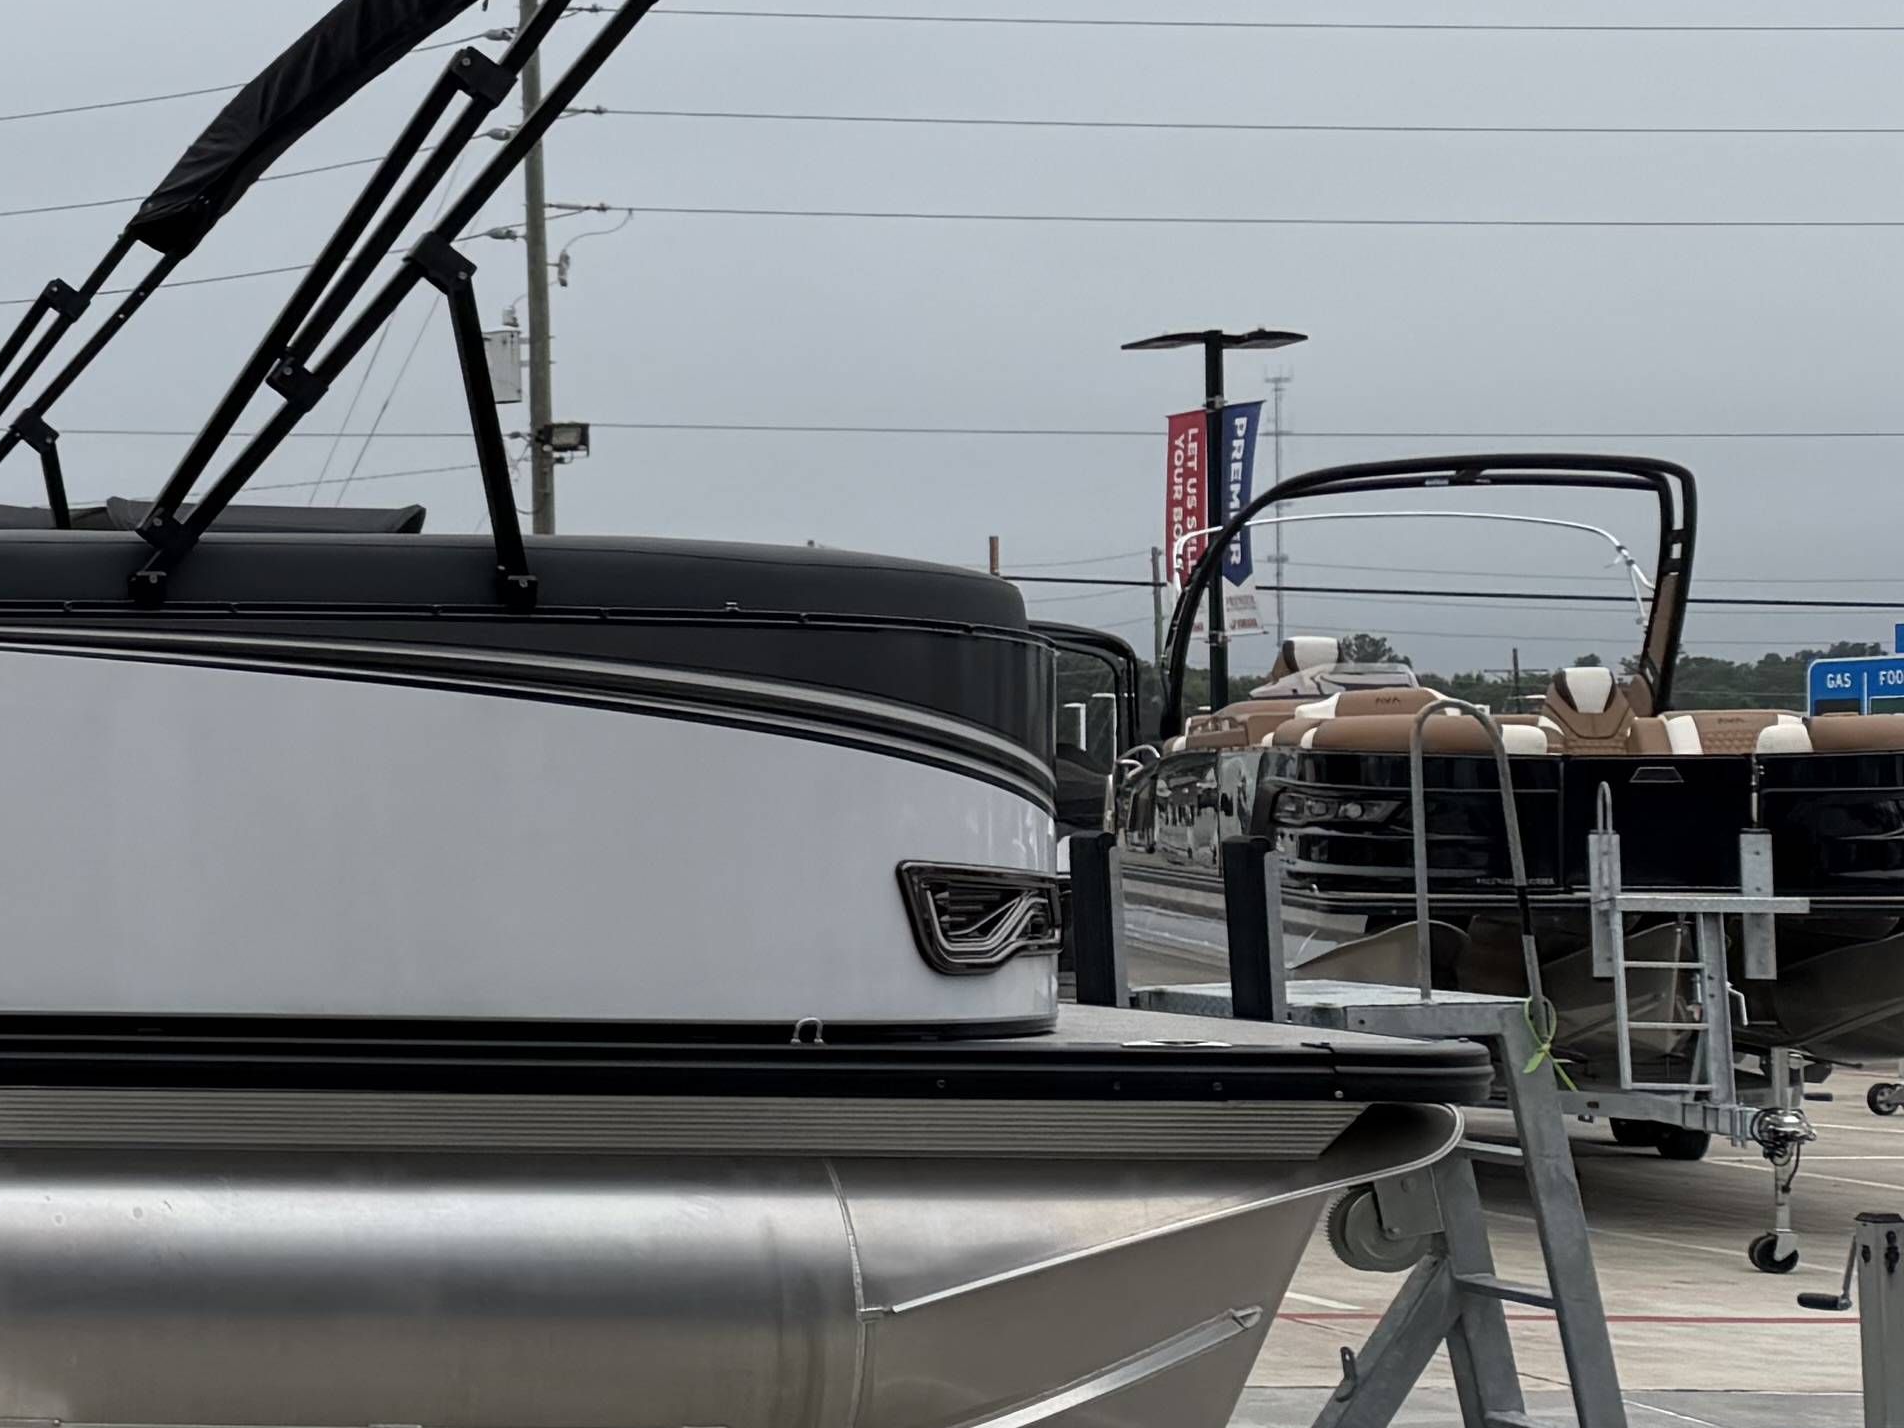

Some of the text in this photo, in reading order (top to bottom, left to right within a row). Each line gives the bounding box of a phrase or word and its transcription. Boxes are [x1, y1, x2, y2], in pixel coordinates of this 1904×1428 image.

[1187, 428, 1198, 470] LET
[1173, 434, 1185, 501] YOUR
[1186, 477, 1198, 509] US
[1826, 672, 1852, 689] GAS
[1879, 670, 1904, 686] FOO
